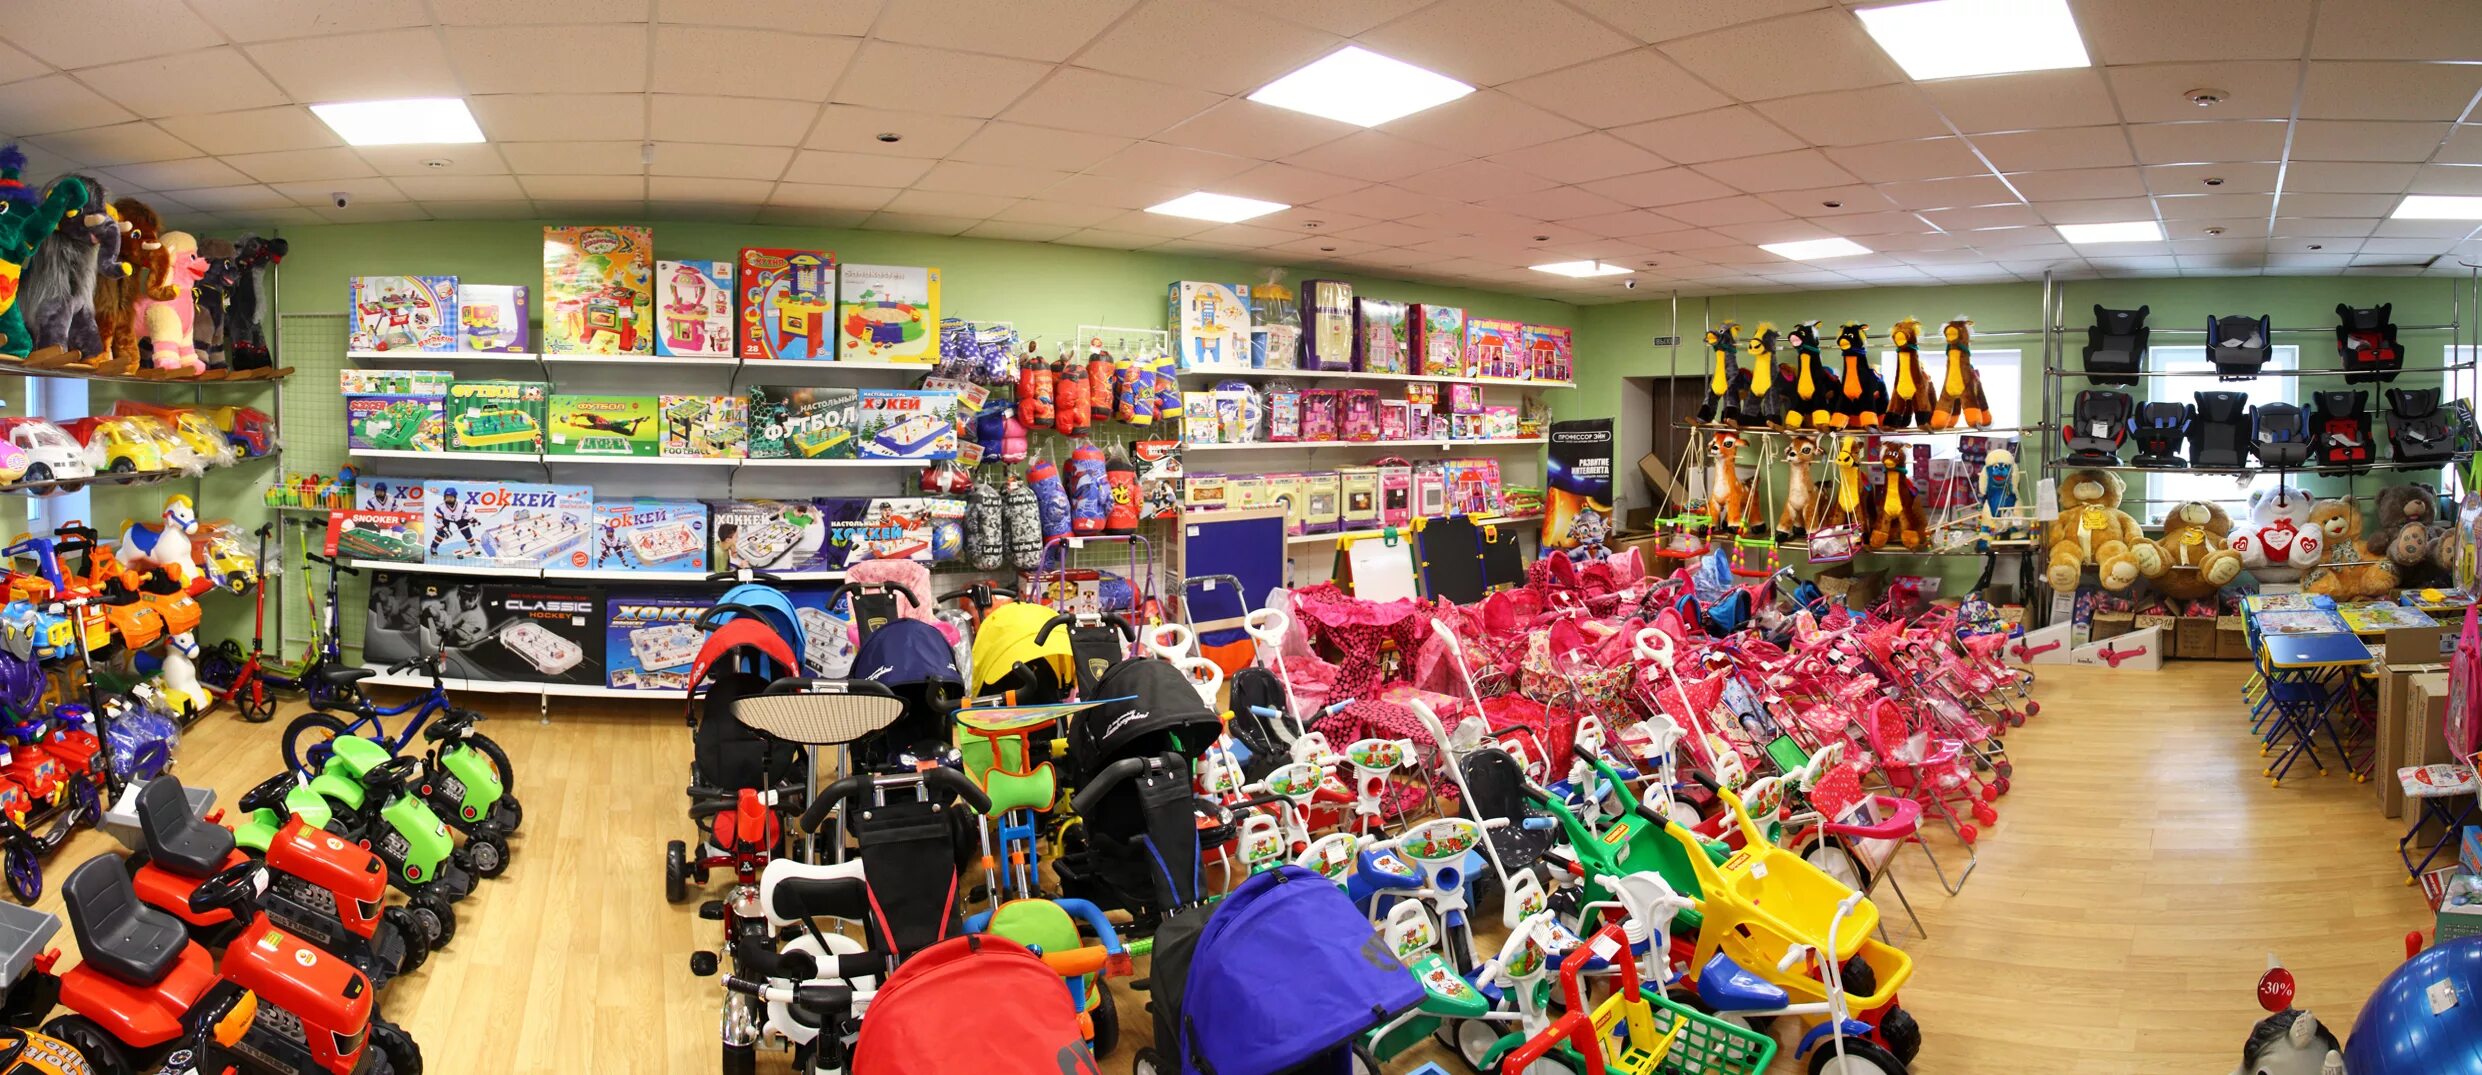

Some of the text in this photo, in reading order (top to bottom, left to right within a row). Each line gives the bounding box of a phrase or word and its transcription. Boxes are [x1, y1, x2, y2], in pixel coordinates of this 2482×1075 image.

[746, 345, 759, 353] 28
[450, 384, 520, 399] ФУТБОЛ
[577, 402, 625, 411] ФУТБОЛ
[800, 394, 858, 413] НАСТОЛЬНЫЙ
[863, 395, 921, 411] ХОКЕЙ
[764, 406, 856, 441] ФУТБОЛ
[664, 447, 711, 455] FOOTBALL
[1579, 458, 1610, 467] РАЗВИТИЕ
[1571, 466, 1610, 475] ИНТЕЛЛЕКТА
[465, 488, 556, 508] ХОККЕЙ
[352, 513, 399, 524] SNOOKER
[716, 511, 771, 526] ХОККЕЙ
[832, 524, 903, 541] ХОККЕЙ
[505, 600, 592, 612] CLASSIC
[613, 605, 709, 622] ХОКК
[2260, 981, 2292, 997] -30%
